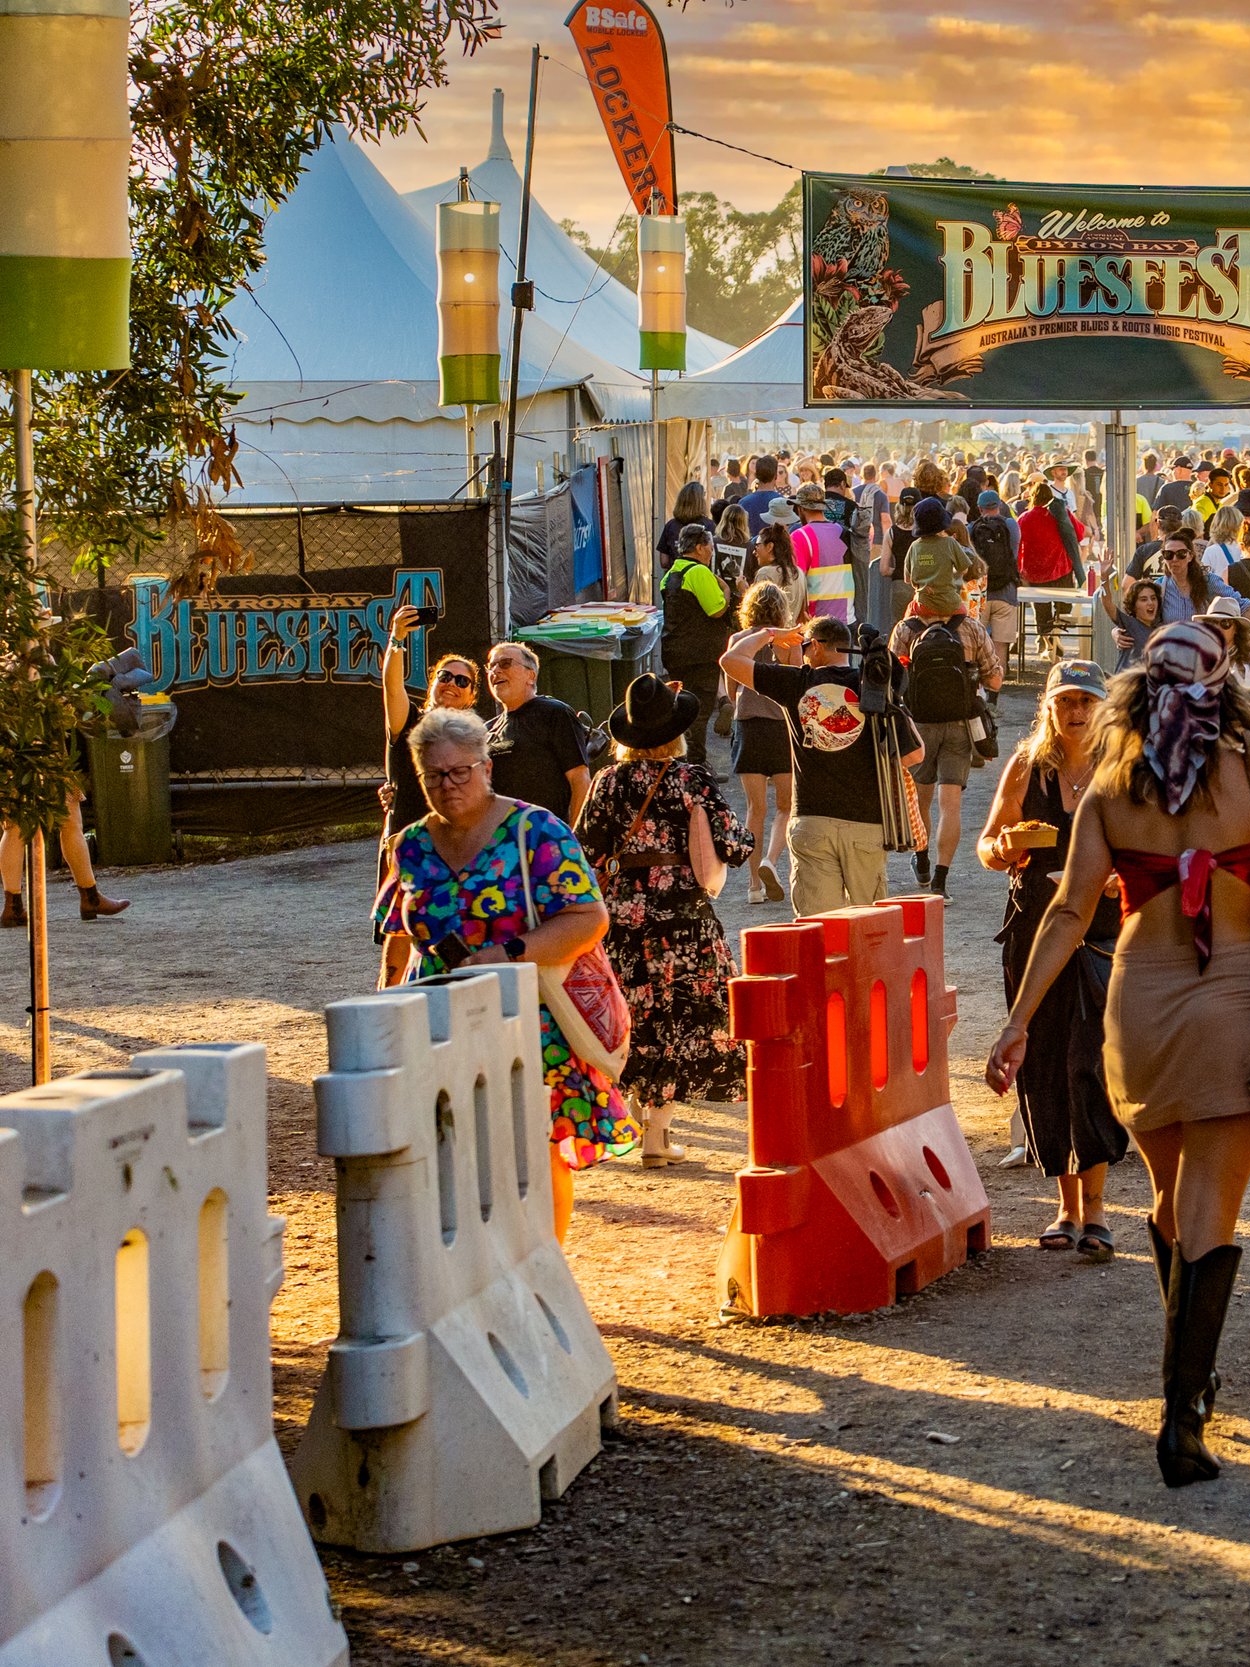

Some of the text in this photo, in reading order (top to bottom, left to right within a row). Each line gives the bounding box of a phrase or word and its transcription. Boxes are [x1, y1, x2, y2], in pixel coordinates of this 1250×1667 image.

[585, 6, 647, 30] BSafe
[1038, 209, 1171, 239] Welcome to
[1034, 240, 1180, 251] BYRON BAY
[979, 320, 1226, 347] AUSTRALIA'S PREMIER BLUES & ROOTS MUSIC FESTIVAL
[193, 596, 367, 609] BYRON BAY
[126, 569, 444, 698] BLUESFEST
